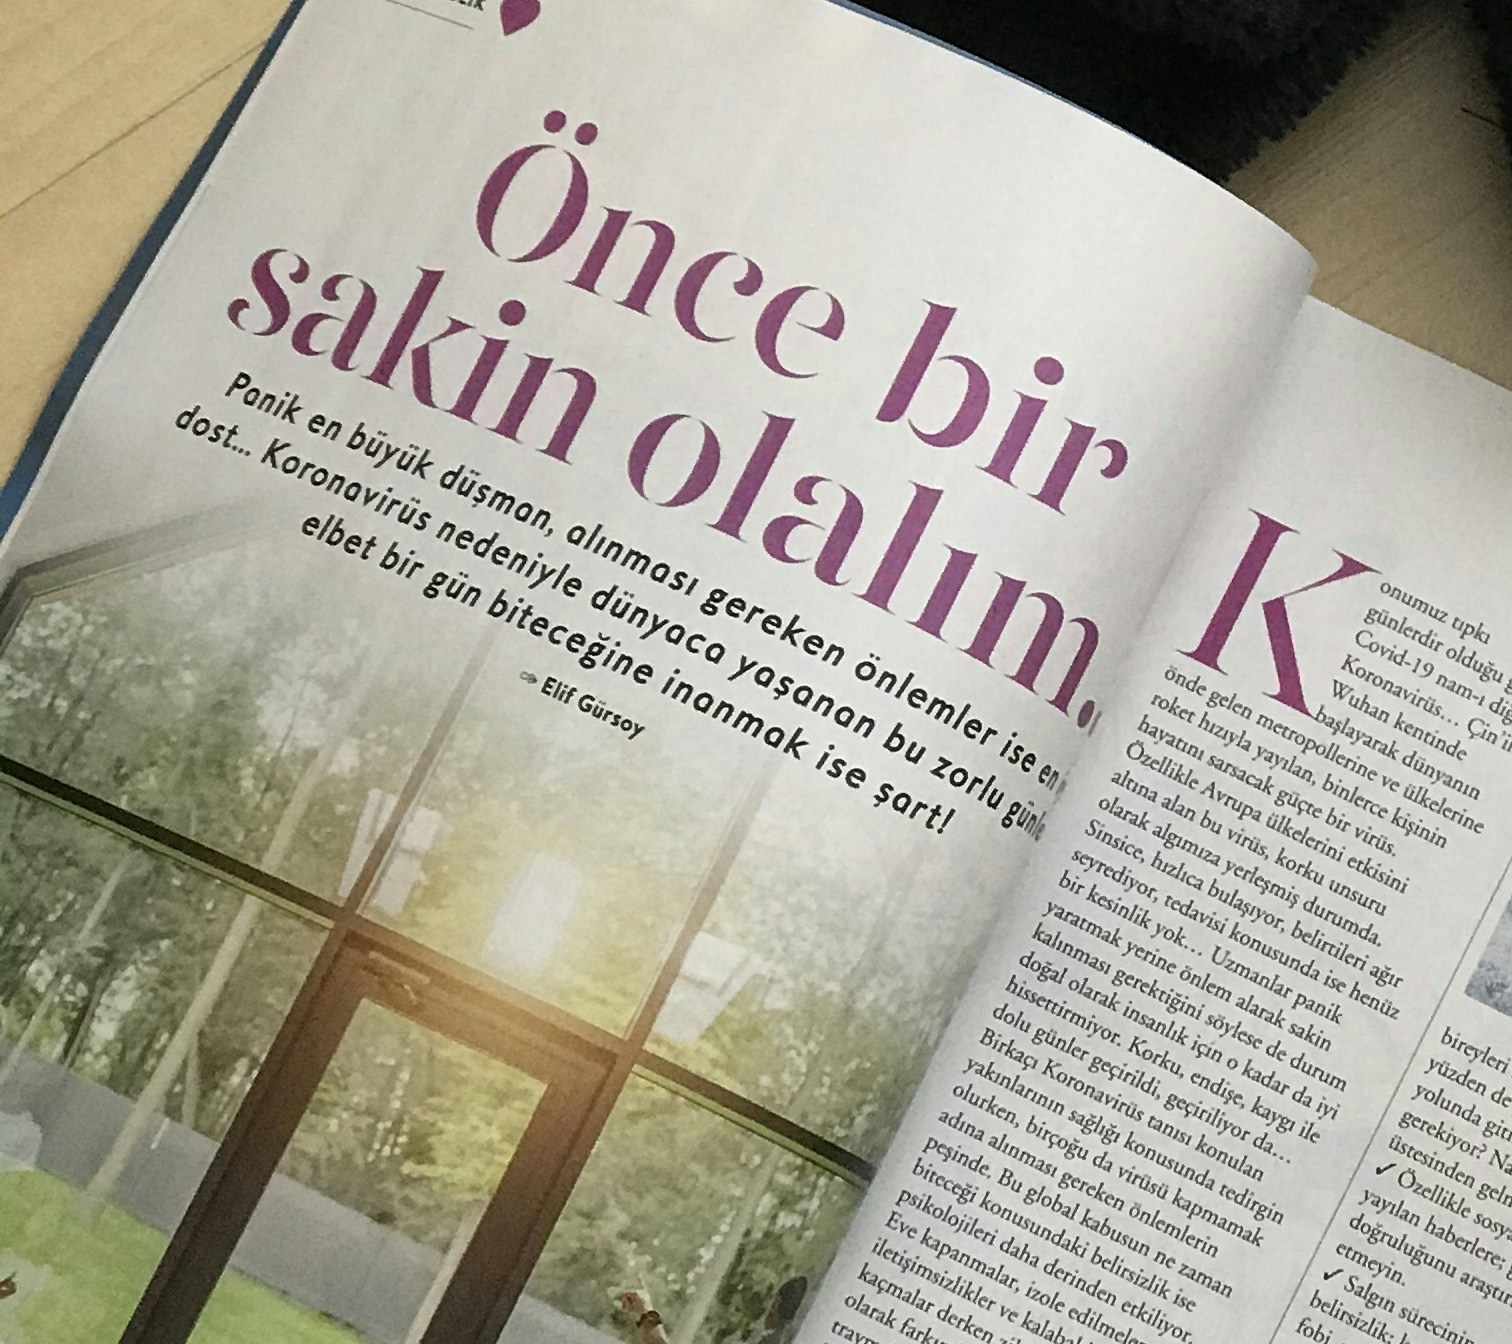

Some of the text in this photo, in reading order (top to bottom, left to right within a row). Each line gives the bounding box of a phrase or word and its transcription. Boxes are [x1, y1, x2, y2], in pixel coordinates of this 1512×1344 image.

[475, 109, 1129, 516] Önce bir
[227, 248, 597, 465] sakin
[224, 371, 303, 425] Panik
[307, 414, 343, 442] en
[345, 421, 435, 480] büyük
[439, 464, 554, 538] düşman,
[566, 523, 700, 597] alınması
[699, 588, 846, 667] gereken
[854, 652, 999, 746] önlemler
[999, 731, 1037, 773] ise
[1037, 764, 1060, 791] en
[260, 437, 433, 532] Koronavirüs
[435, 521, 583, 598] nedeniyle
[590, 584, 726, 665] dünyaca
[727, 654, 876, 739] yaşanan
[882, 722, 927, 765] bu
[929, 755, 1005, 811] zorlu
[1354, 629, 1435, 679] Covid-19
[1363, 607, 1444, 653] günlerdir
[1445, 645, 1504, 684] olduğu
[1451, 616, 1491, 645] tıpkı
[301, 514, 957, 835] elbet bir gün biteceğine inanmak ise şart!
[540, 676, 646, 741] Elif Gürsoy
[1164, 665, 1485, 835] önde gelen metropollerine ve ülkelerine
[1312, 704, 1481, 801] başlayarak dünyanın
[1332, 678, 1468, 762] Wuhan kentinde
[1150, 694, 1448, 850] roket hızıyla yayılan, binlerce kişinin
[1423, 1058, 1487, 1097] yüzden
[1490, 1086, 1512, 1108] de
[1440, 1025, 1511, 1074] bireyleri
[1397, 1167, 1472, 1219] Özellikle
[844, 1293, 897, 1330] olarak
